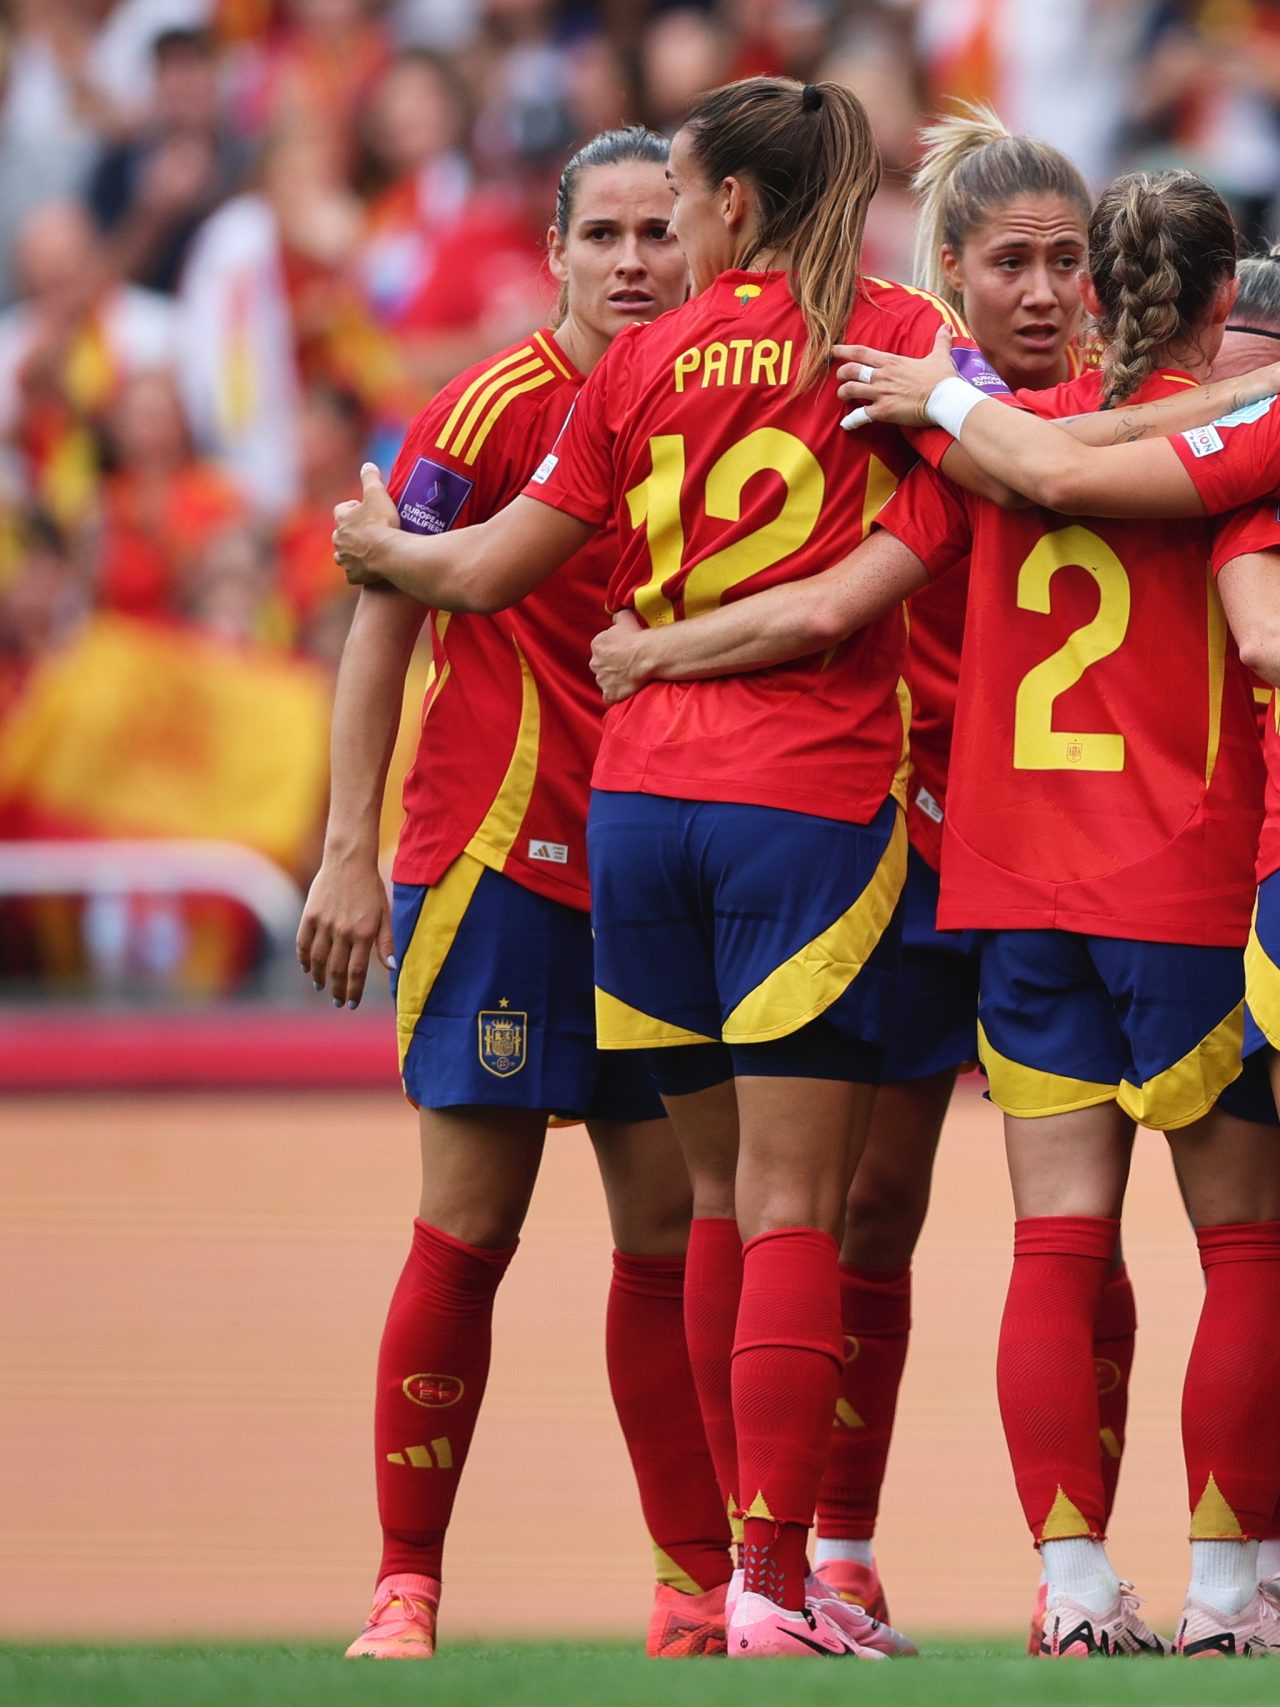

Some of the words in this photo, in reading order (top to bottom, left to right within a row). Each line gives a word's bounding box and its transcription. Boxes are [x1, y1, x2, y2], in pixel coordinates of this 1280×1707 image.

[674, 339, 794, 392] PATRI
[403, 503, 445, 527] EUROPEAN
[624, 426, 826, 629] 12
[1013, 524, 1131, 771] 2
